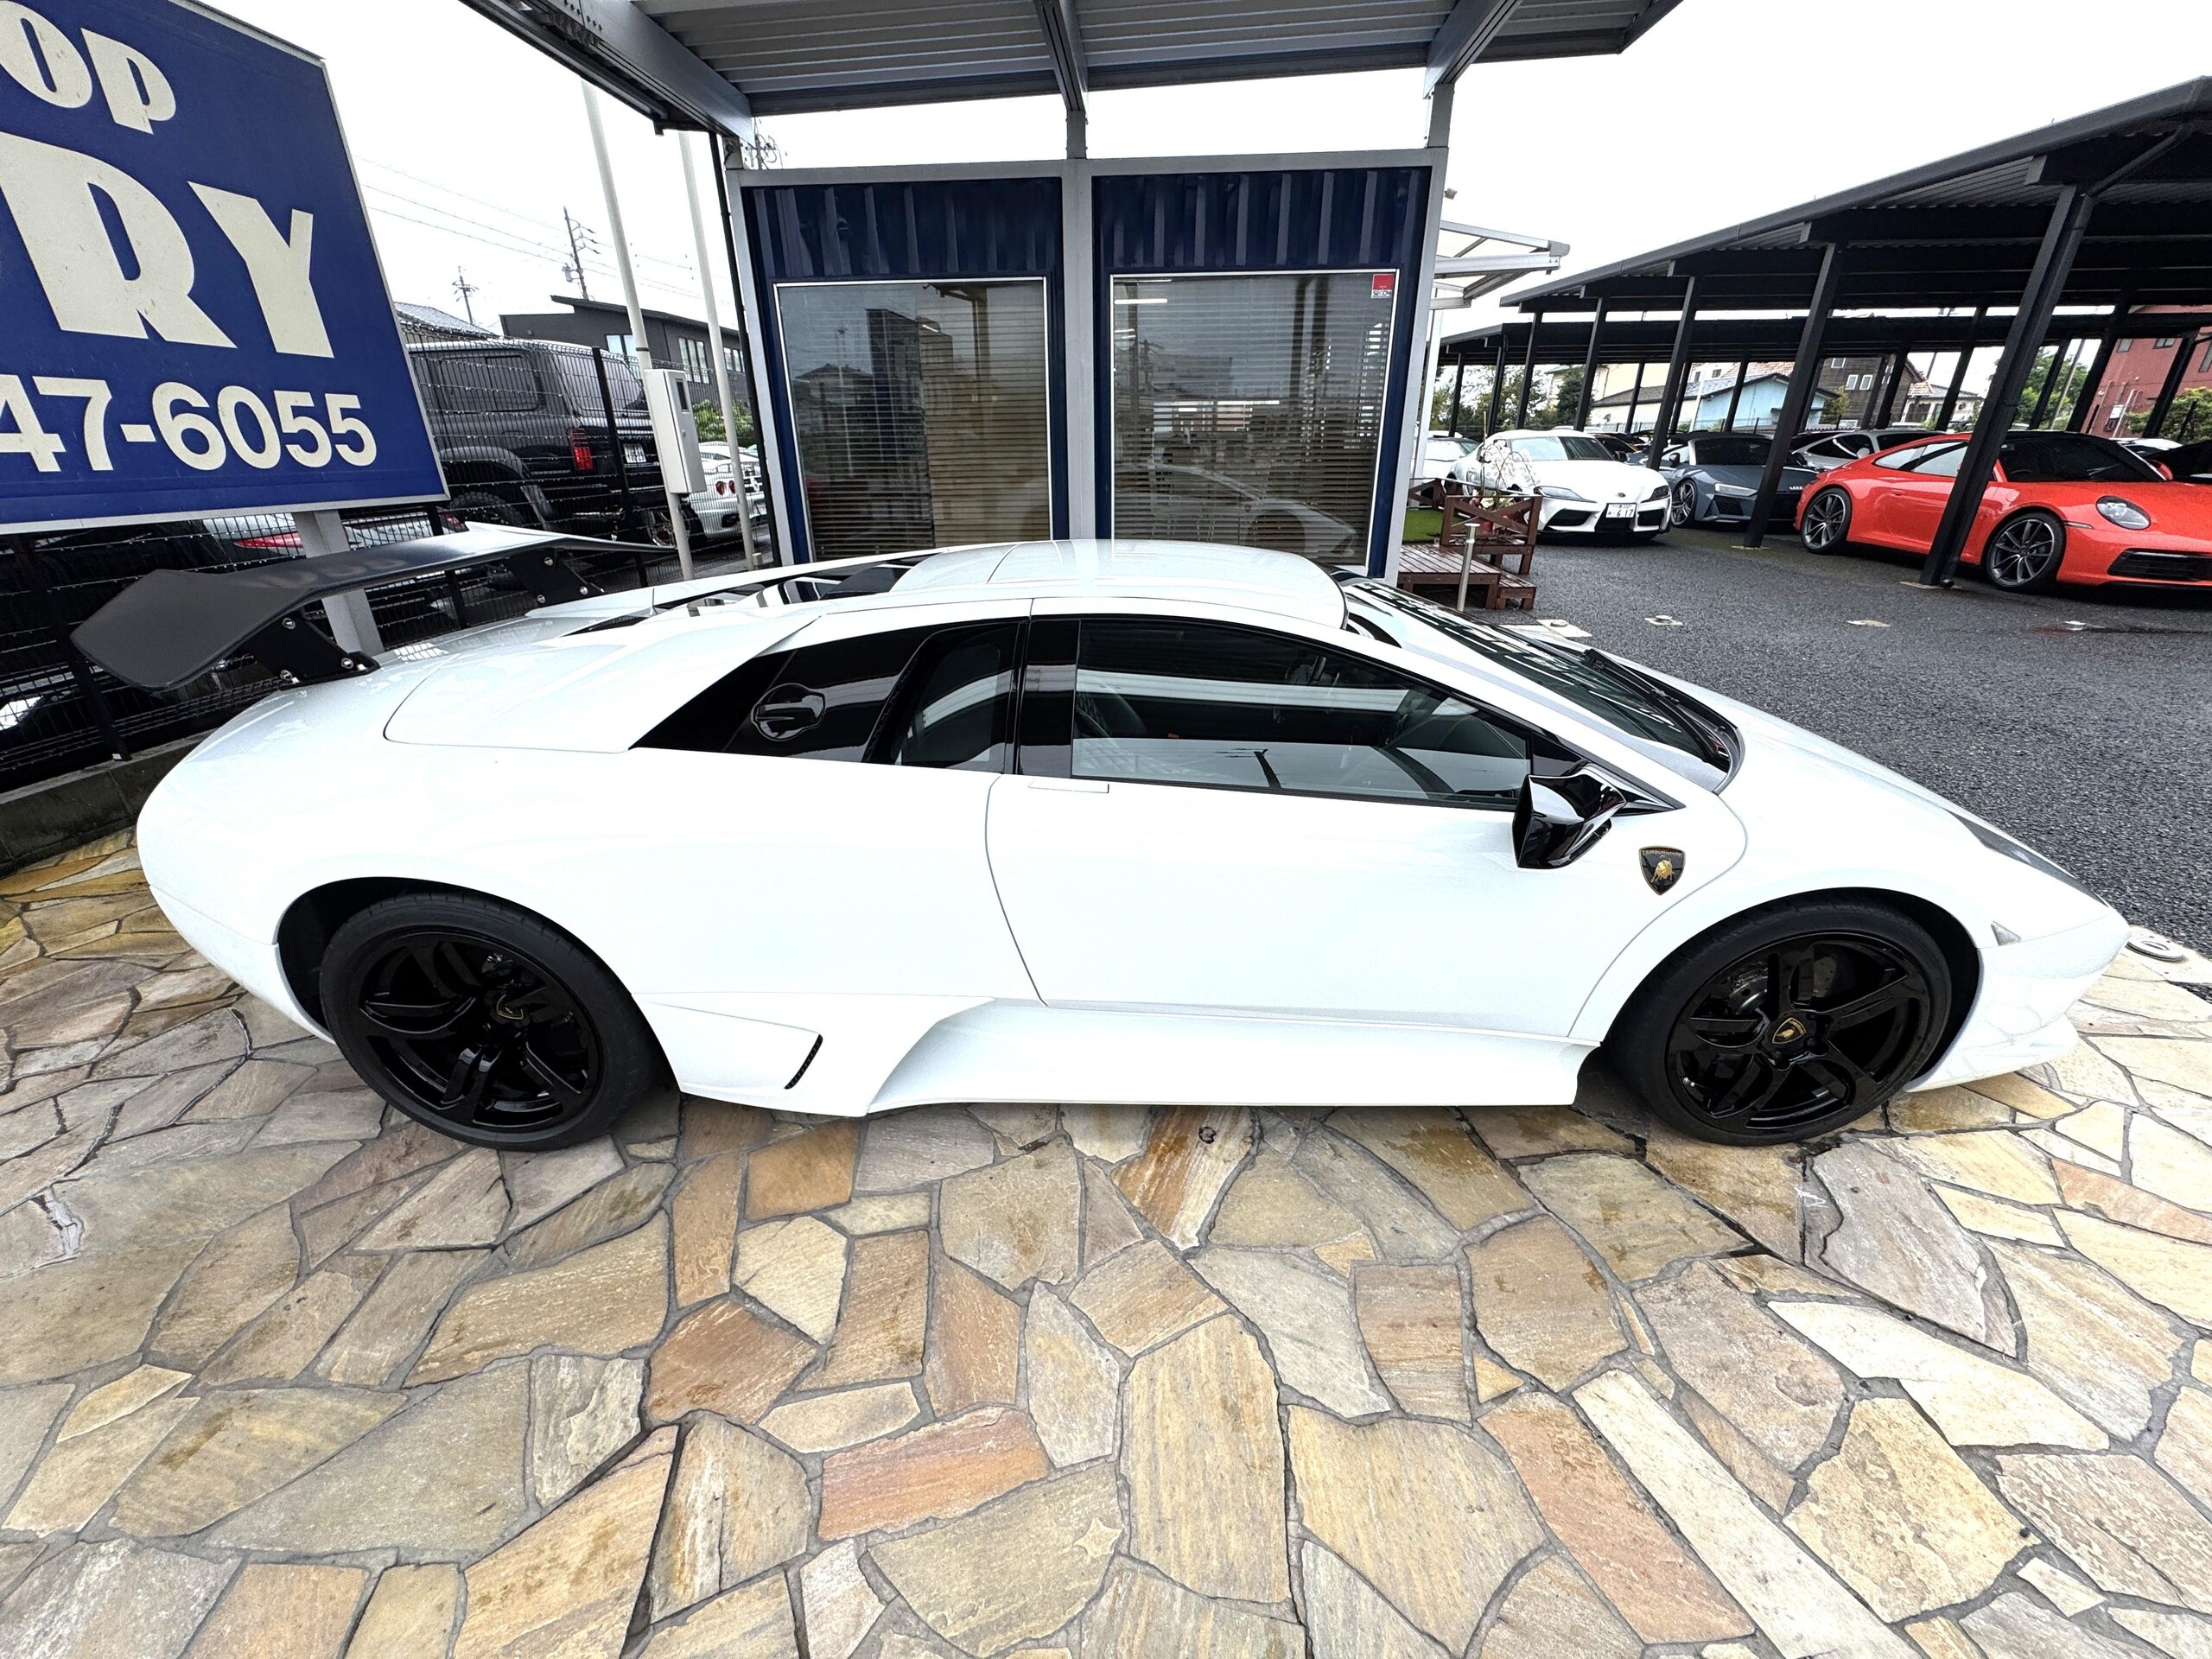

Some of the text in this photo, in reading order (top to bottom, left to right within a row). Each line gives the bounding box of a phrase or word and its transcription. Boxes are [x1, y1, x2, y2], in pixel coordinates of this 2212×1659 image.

[0, 0, 176, 134] OP
[0, 131, 334, 358] RY
[0, 374, 377, 471] 47-6055
